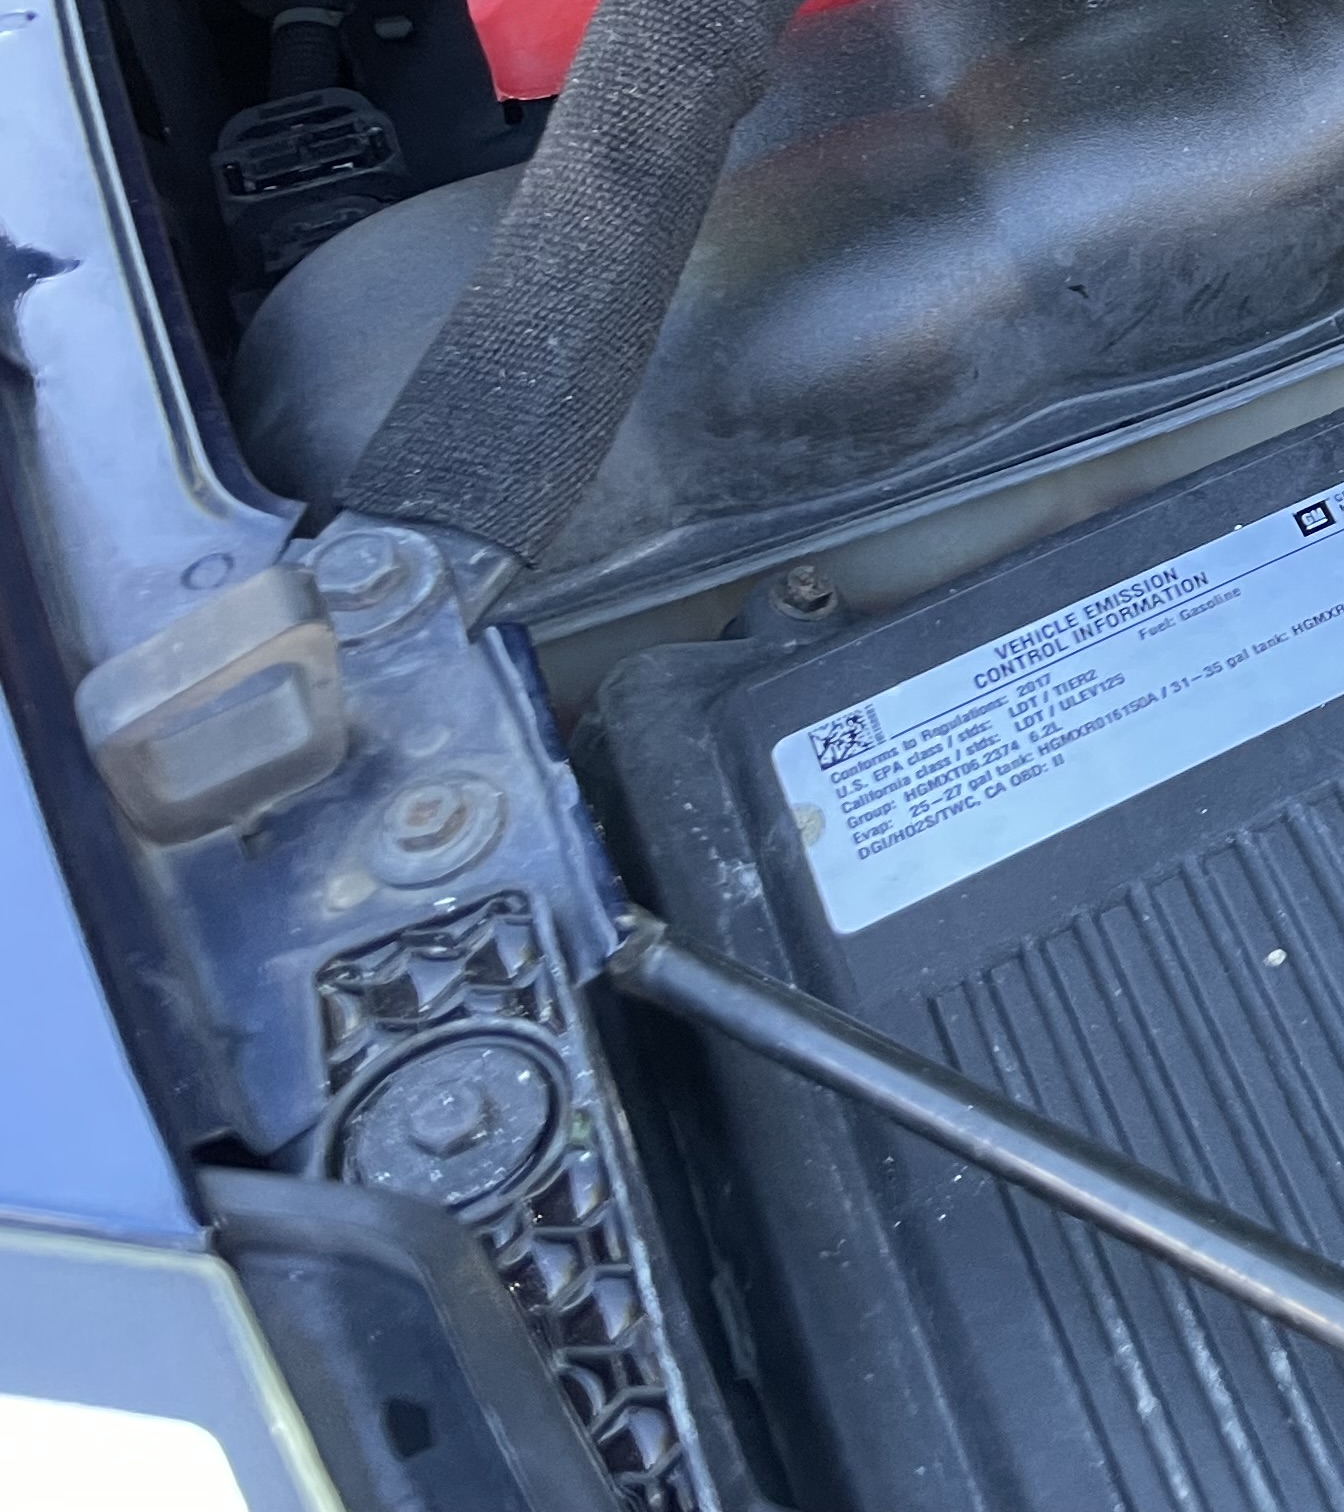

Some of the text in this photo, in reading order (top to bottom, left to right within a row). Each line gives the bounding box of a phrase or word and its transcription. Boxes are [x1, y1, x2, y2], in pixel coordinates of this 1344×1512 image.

[973, 571, 1208, 689] CONTROL INFORMATION
[993, 567, 1178, 659] VEHICLE EMISSION
[1137, 587, 1241, 640] Fuel: Gasoline
[829, 746, 899, 784] Conforms
[901, 737, 917, 751] to
[918, 694, 1009, 742] Regulations:
[1015, 671, 1051, 698] 2017
[835, 778, 869, 799] U.S.
[871, 760, 904, 782] EPA
[906, 742, 944, 766] class
[956, 719, 992, 743] stds:
[1007, 694, 1037, 718] LDT
[1051, 668, 1098, 696] TIER2
[839, 775, 912, 814] California
[914, 756, 952, 779] class
[965, 733, 1001, 756] stds:
[1013, 708, 1044, 733] LDT
[1057, 672, 1125, 711] ULEV125
[846, 799, 896, 829] Group:
[1027, 720, 1064, 743] 6.2L
[850, 819, 894, 845] Evap:
[966, 769, 992, 791] gal
[994, 752, 1034, 777] tank:
[1225, 647, 1249, 669] gal
[1251, 631, 1290, 655] tank:
[983, 781, 1007, 799] CA
[1008, 762, 1049, 787] OBD:
